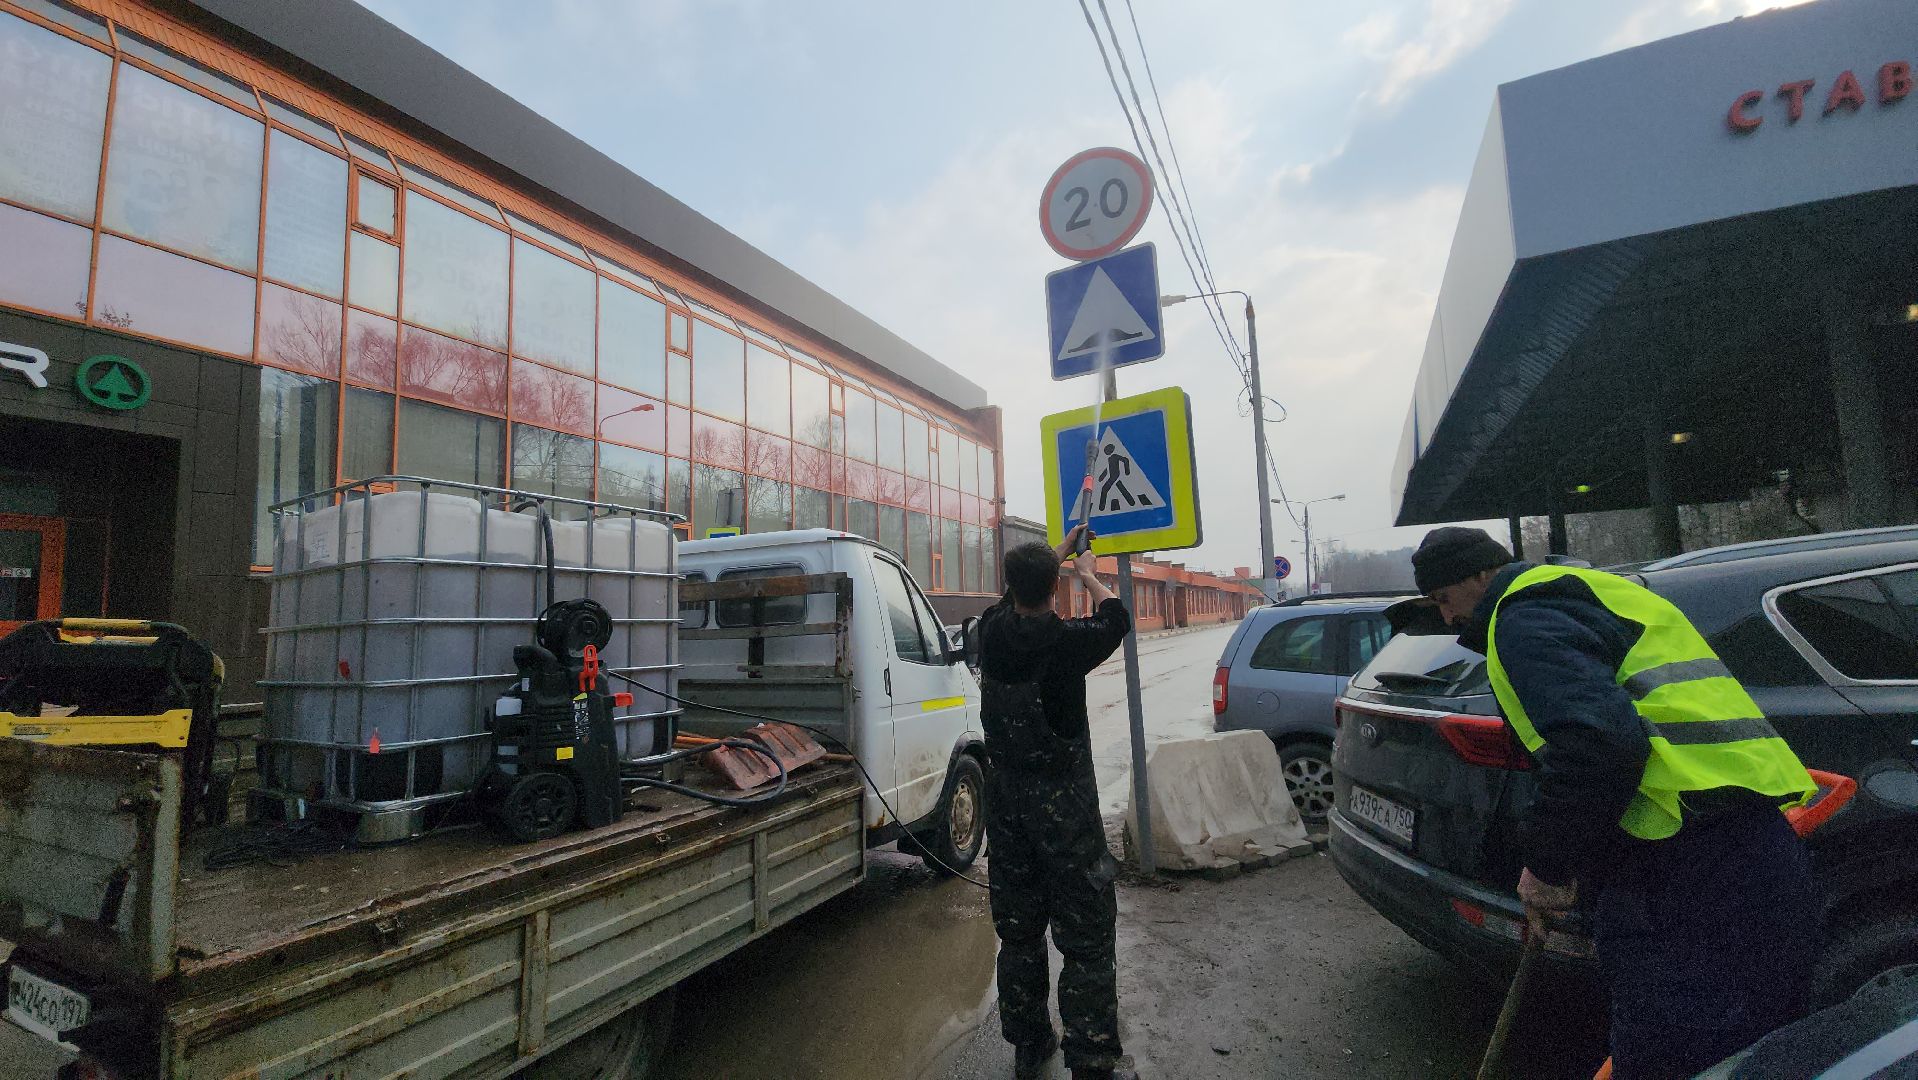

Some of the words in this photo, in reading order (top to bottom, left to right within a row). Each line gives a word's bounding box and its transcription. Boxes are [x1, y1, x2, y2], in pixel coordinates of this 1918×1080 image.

[1064, 178, 1128, 232] 20
[0, 341, 49, 388] R
[1394, 805, 1413, 829] 750
